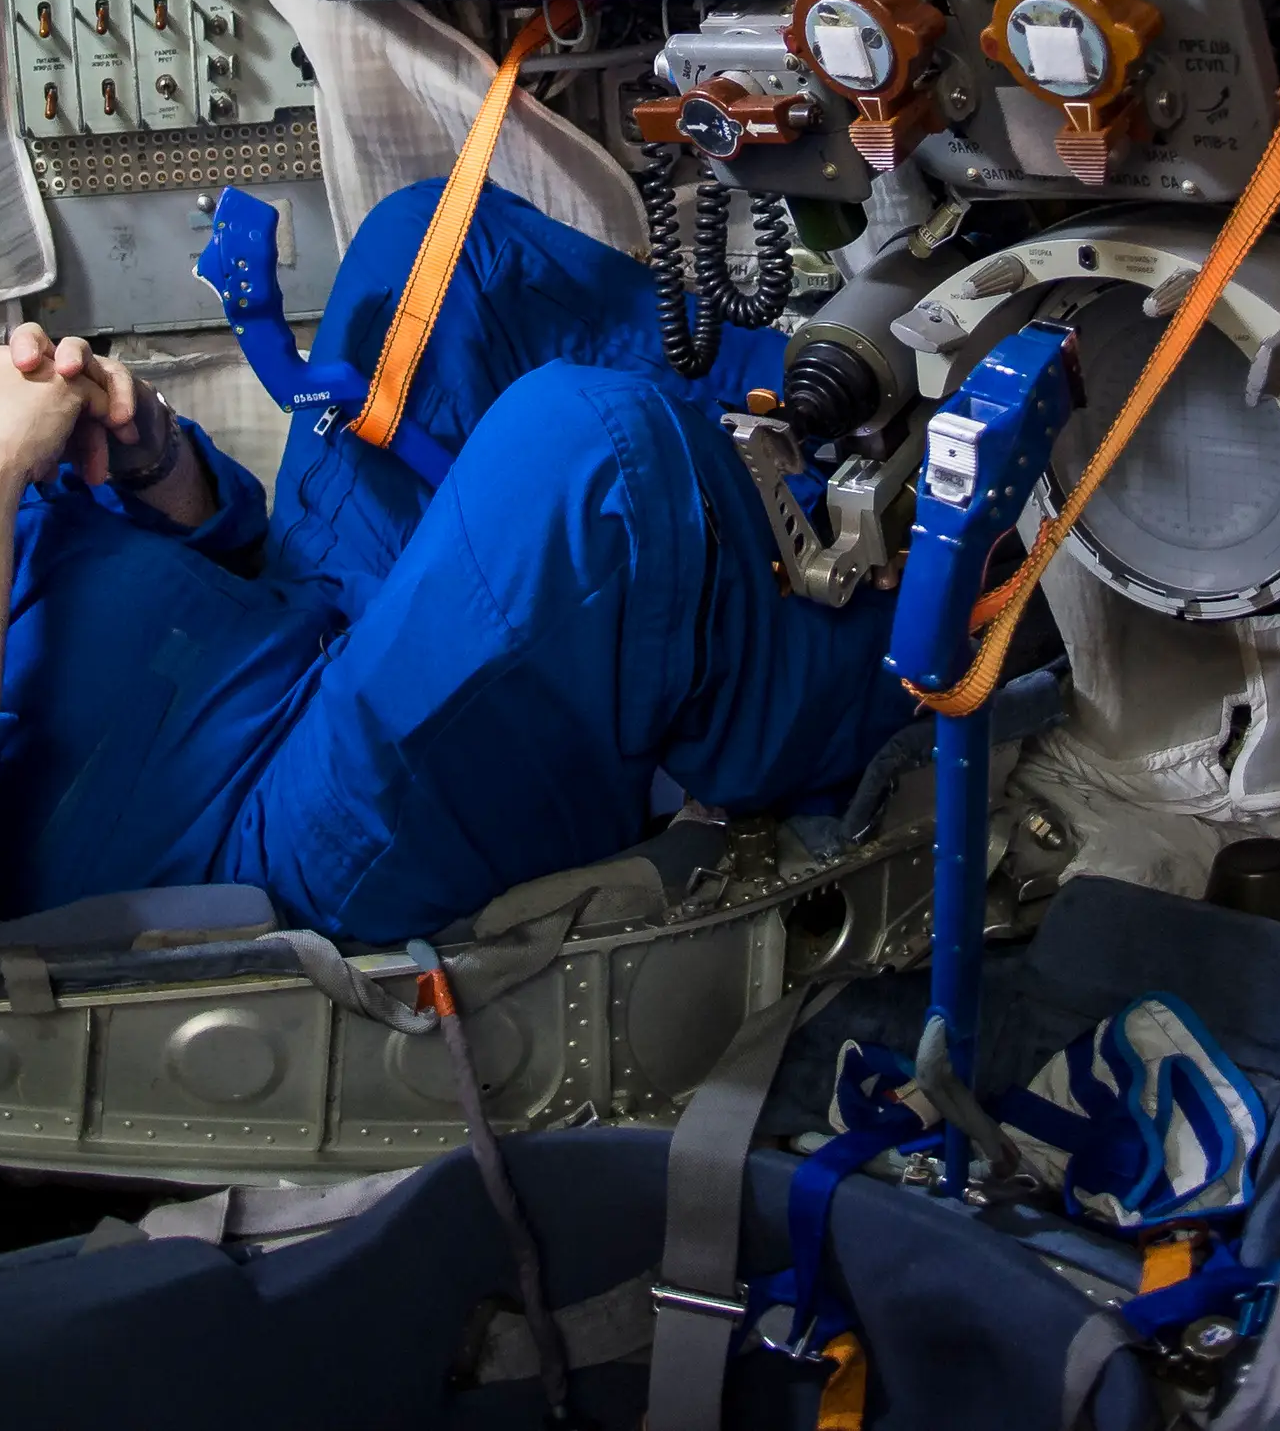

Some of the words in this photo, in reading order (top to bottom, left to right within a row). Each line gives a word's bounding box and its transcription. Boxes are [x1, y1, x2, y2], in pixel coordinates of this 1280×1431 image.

[1193, 134, 1238, 150] РПВ-2
[982, 168, 1024, 182] ЗАПАС
[1161, 175, 1180, 188] СА
